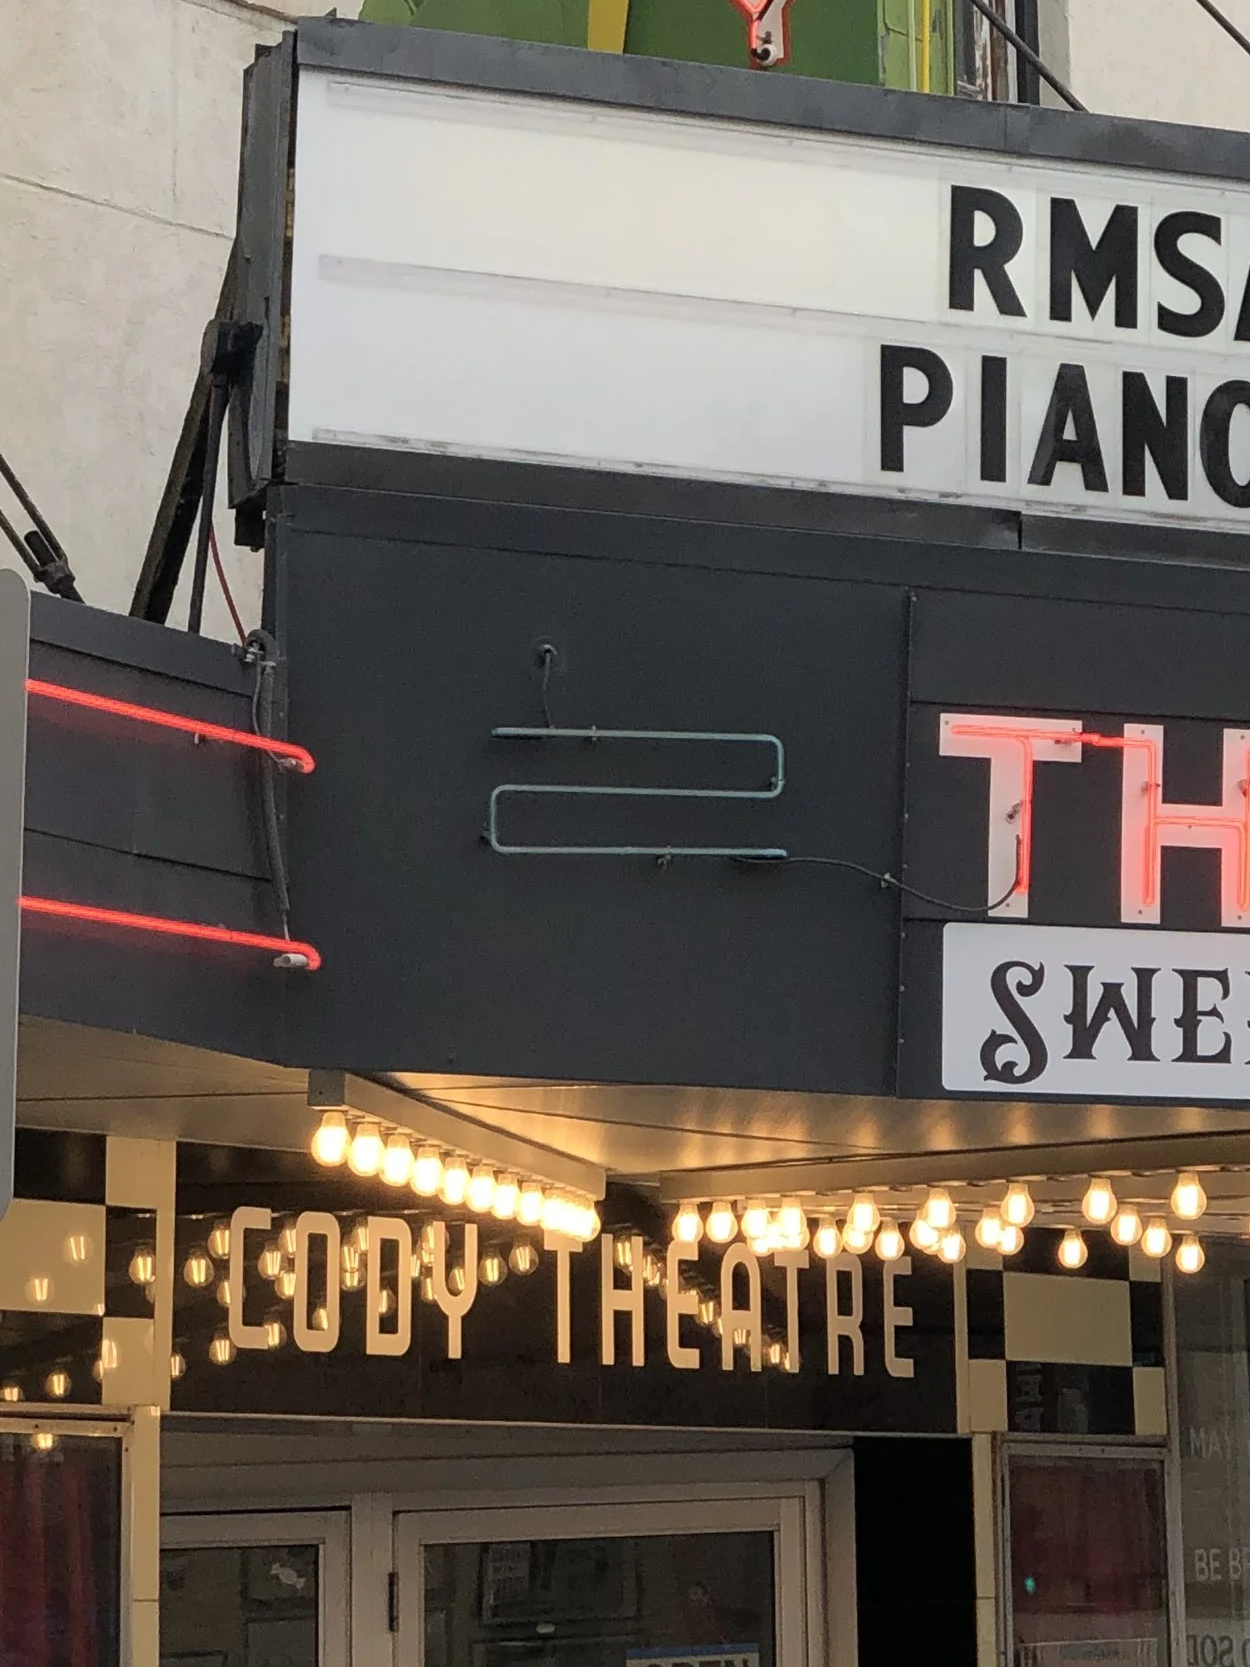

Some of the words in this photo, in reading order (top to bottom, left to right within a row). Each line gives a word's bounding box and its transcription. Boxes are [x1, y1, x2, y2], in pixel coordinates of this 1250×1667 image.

[229, 1206, 478, 1359] CODY
[544, 1222, 915, 1378] THEATRE
[1194, 1548, 1223, 1581] BE
